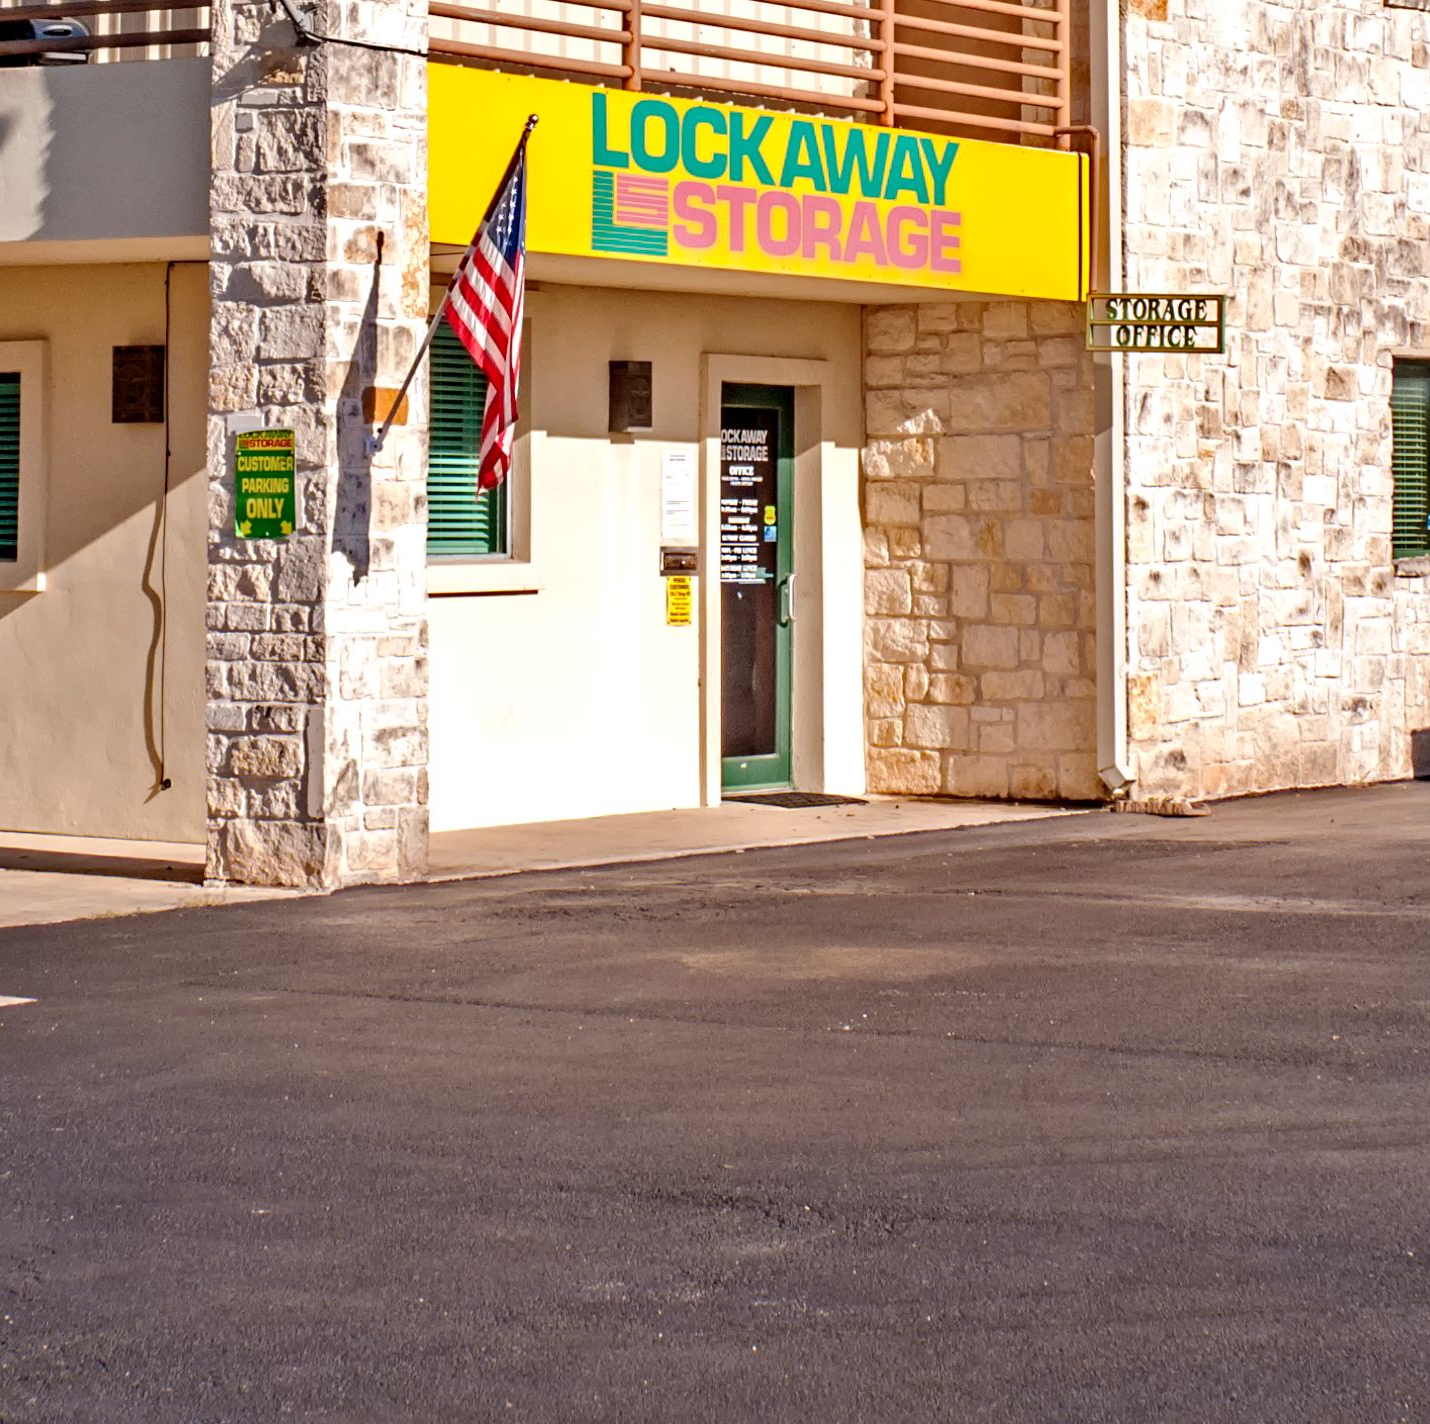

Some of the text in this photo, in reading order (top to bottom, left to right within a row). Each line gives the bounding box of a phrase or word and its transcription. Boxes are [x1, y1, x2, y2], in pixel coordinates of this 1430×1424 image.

[673, 181, 962, 273] STORAGE
[1106, 298, 1208, 321] STORAGE
[1116, 325, 1197, 348] OFFICE
[250, 439, 292, 448] STORAGE
[726, 445, 769, 462] STORAGE
[237, 456, 293, 471] CUSTOMER
[242, 478, 289, 493] PARKING
[246, 498, 284, 519] ONLY
